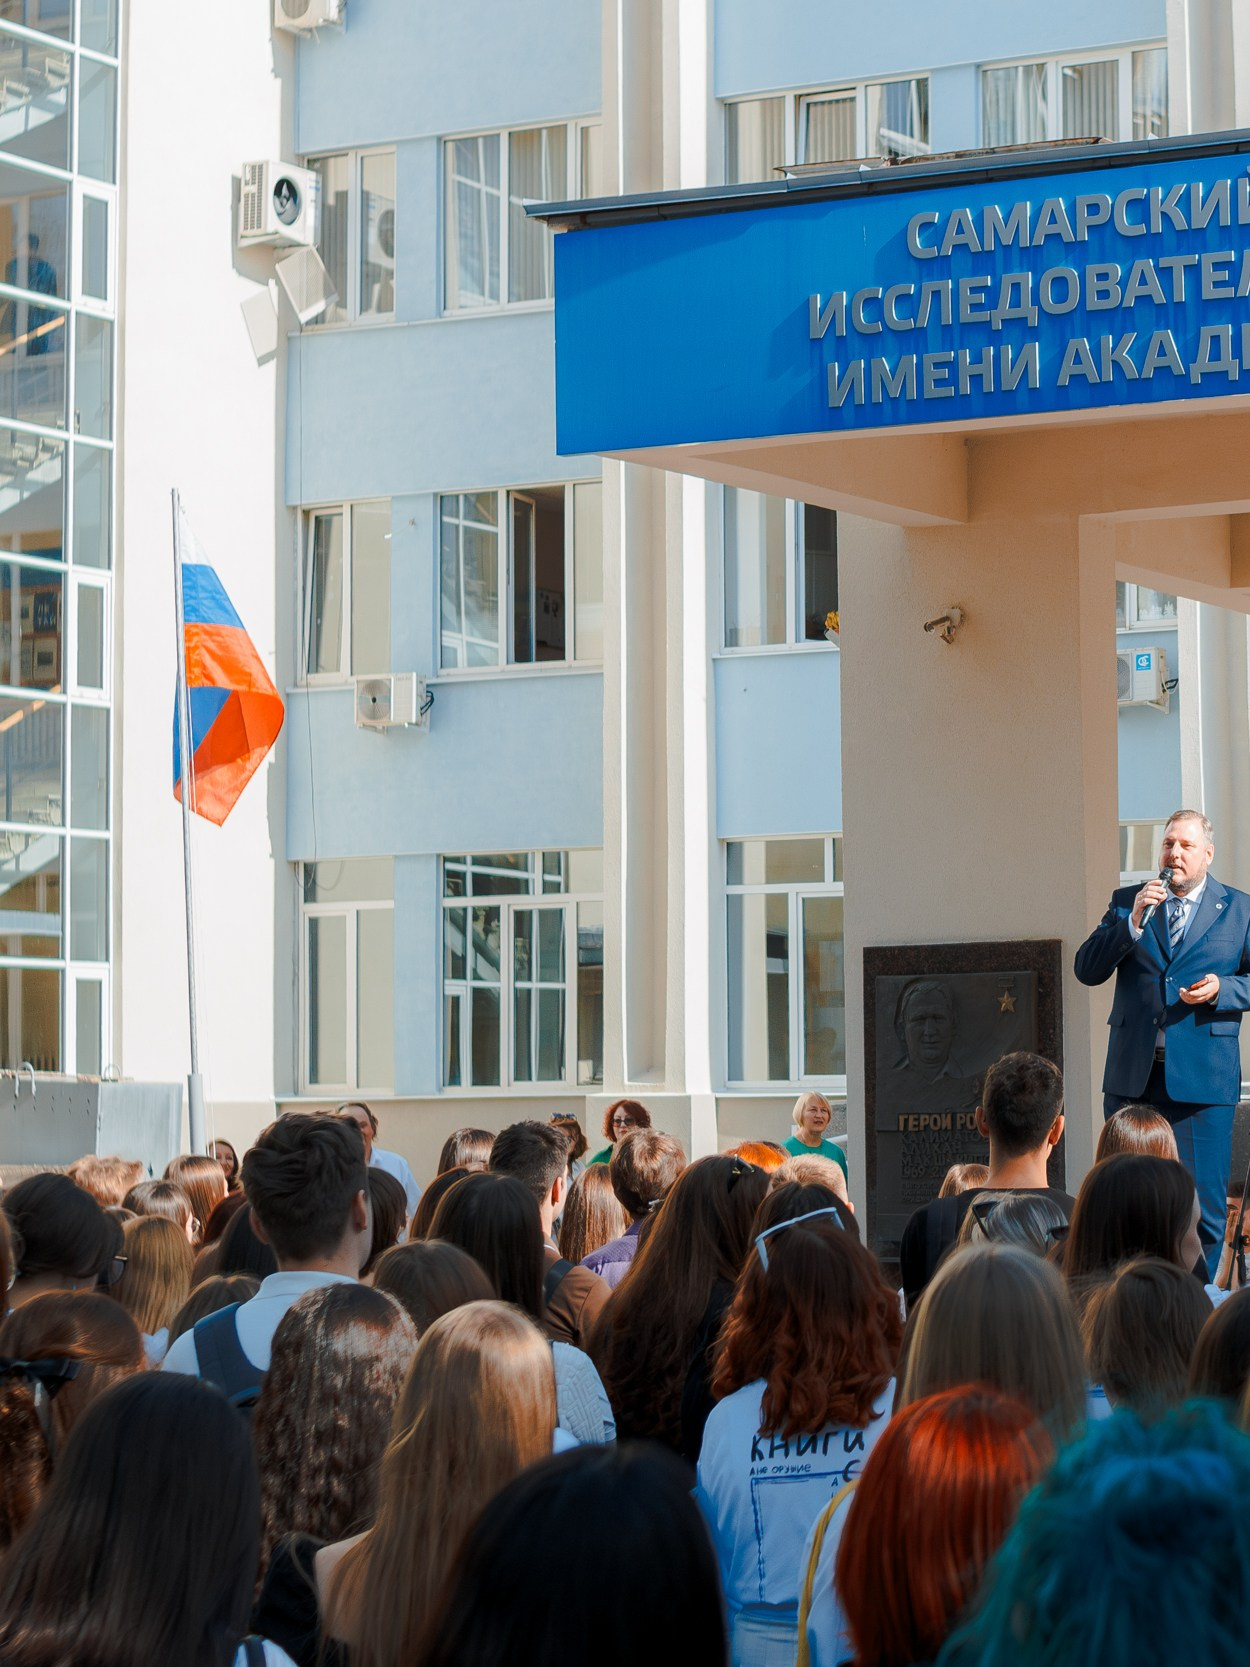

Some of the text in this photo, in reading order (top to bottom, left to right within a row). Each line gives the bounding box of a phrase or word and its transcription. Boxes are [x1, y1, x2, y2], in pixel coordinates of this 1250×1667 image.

[826, 341, 1041, 409] ИМЕНИ
[898, 1109, 953, 1131] ГЕРОЙ
[901, 1131, 989, 1144] КАЛИМАТО
[751, 1430, 865, 1462] КНИГИ
